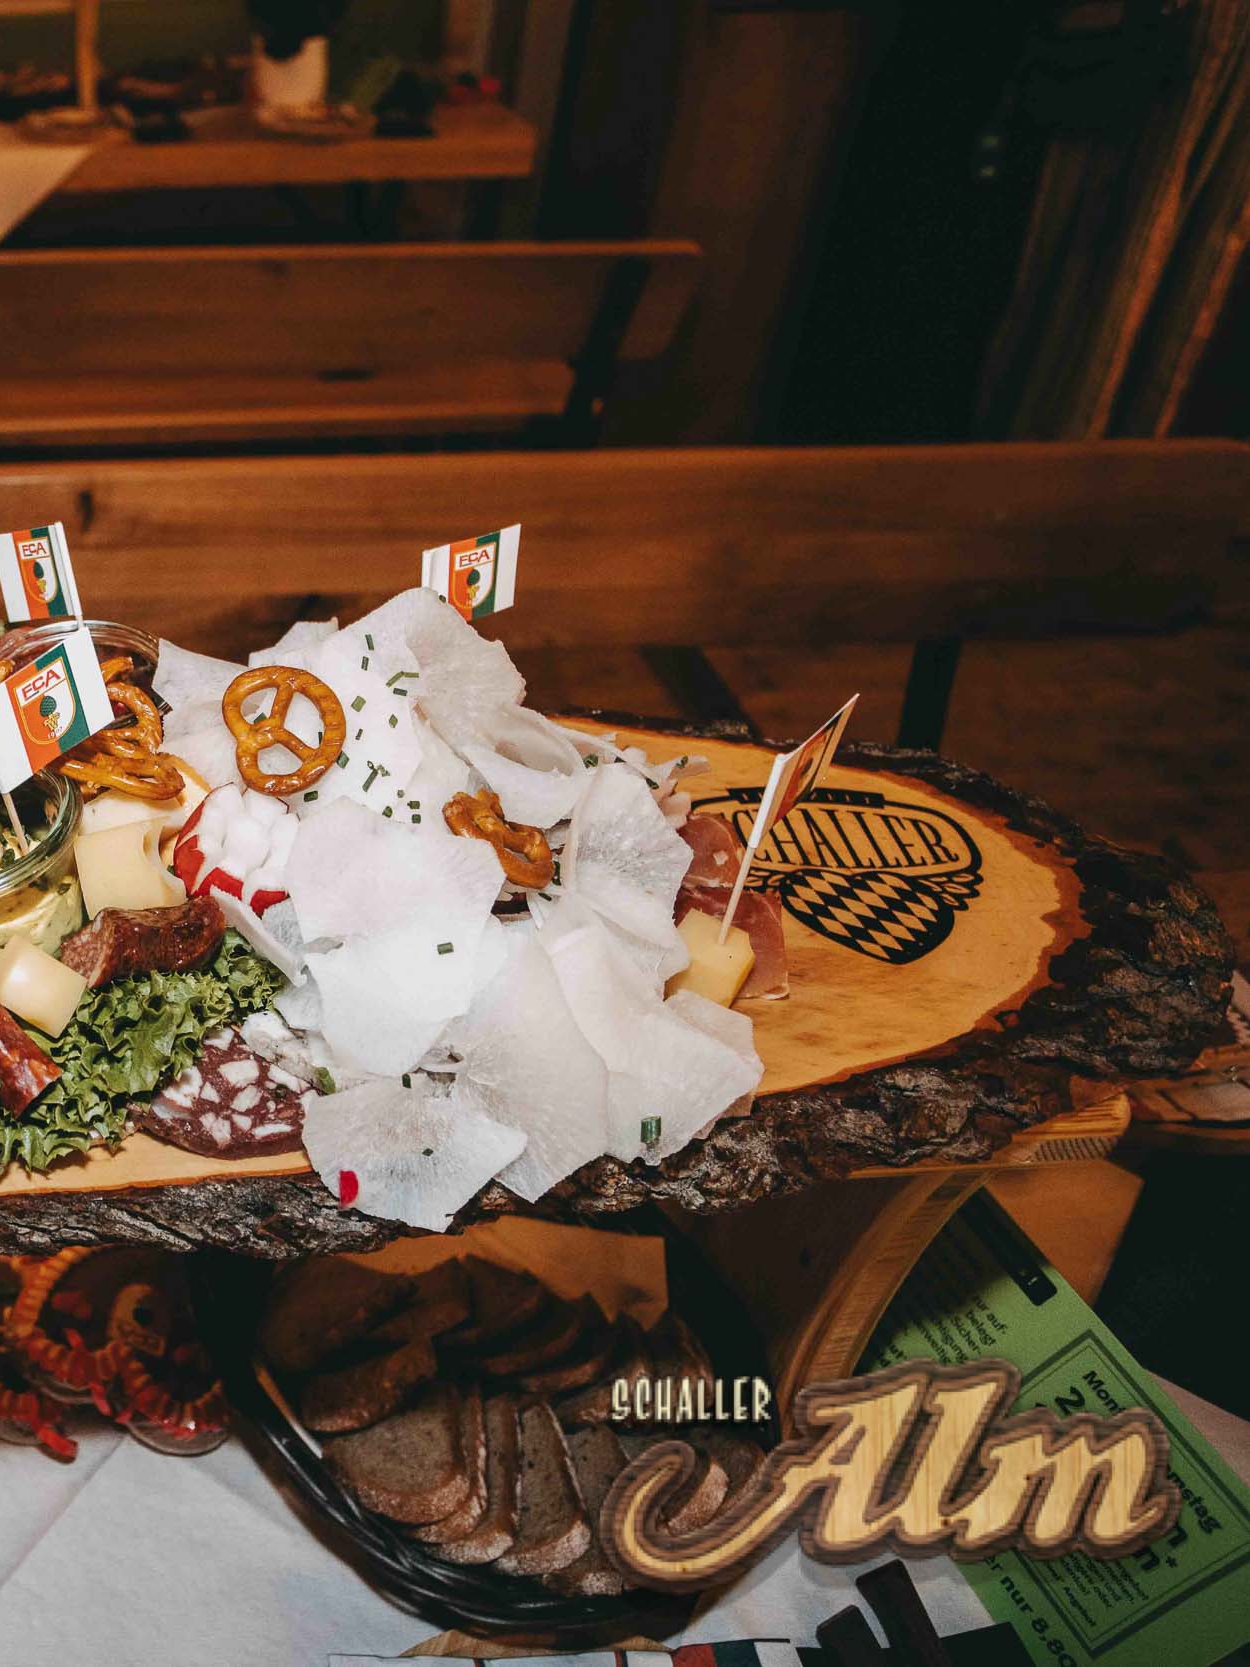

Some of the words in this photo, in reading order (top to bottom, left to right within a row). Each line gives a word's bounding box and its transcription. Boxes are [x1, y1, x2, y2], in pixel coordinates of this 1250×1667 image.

[21, 541, 47, 558] FCA
[458, 549, 490, 567] FCA
[21, 669, 62, 700] FCA
[720, 808, 959, 868] CHALLER
[999, 1574, 1034, 1614] nur
